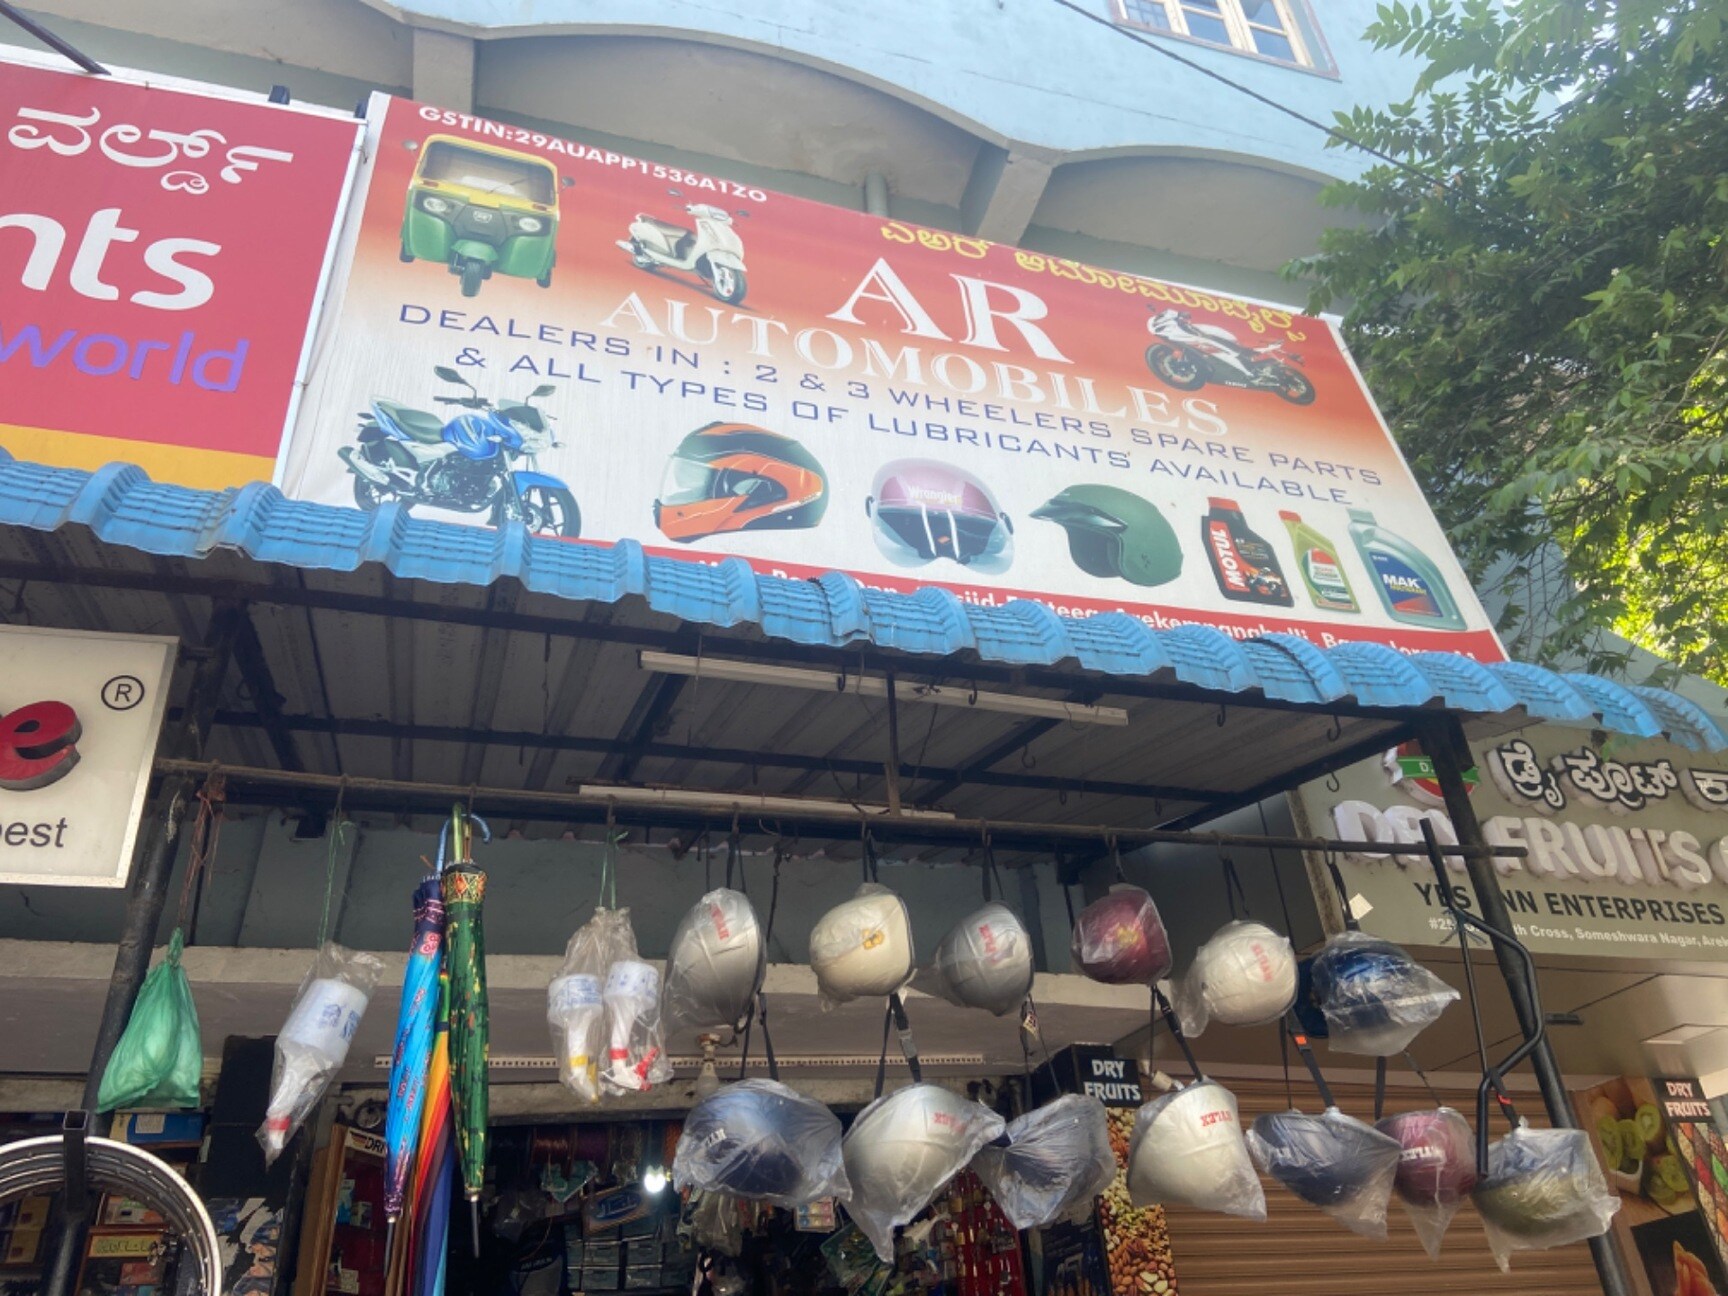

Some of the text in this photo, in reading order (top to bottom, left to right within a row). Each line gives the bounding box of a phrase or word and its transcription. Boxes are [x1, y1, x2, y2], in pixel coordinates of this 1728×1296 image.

[826, 257, 1074, 364] AR
[600, 291, 1228, 437] AUTOMOBILES
[399, 304, 630, 356] DEALERS
[656, 345, 699, 370] IN
[755, 364, 778, 383] 2
[800, 373, 826, 392] &
[847, 380, 870, 399] 3
[889, 388, 1111, 438] WHEELERS
[1131, 427, 1255, 464] SPARE
[1270, 452, 1382, 486] PARTS
[455, 347, 1353, 505] & ALL TYPES OF LUBRICANTS AVAILABLE
[1383, 574, 1420, 589] MAK
[0, 817, 67, 848] est
[1482, 815, 1711, 888] FRUITS
[1544, 892, 1725, 925] ENTERPRISES
[1091, 1059, 1125, 1079] DRY
[1083, 1081, 1141, 1101] FRUITS
[1666, 1082, 1693, 1097] DRY
[1664, 1101, 1711, 1118] FRUITS
